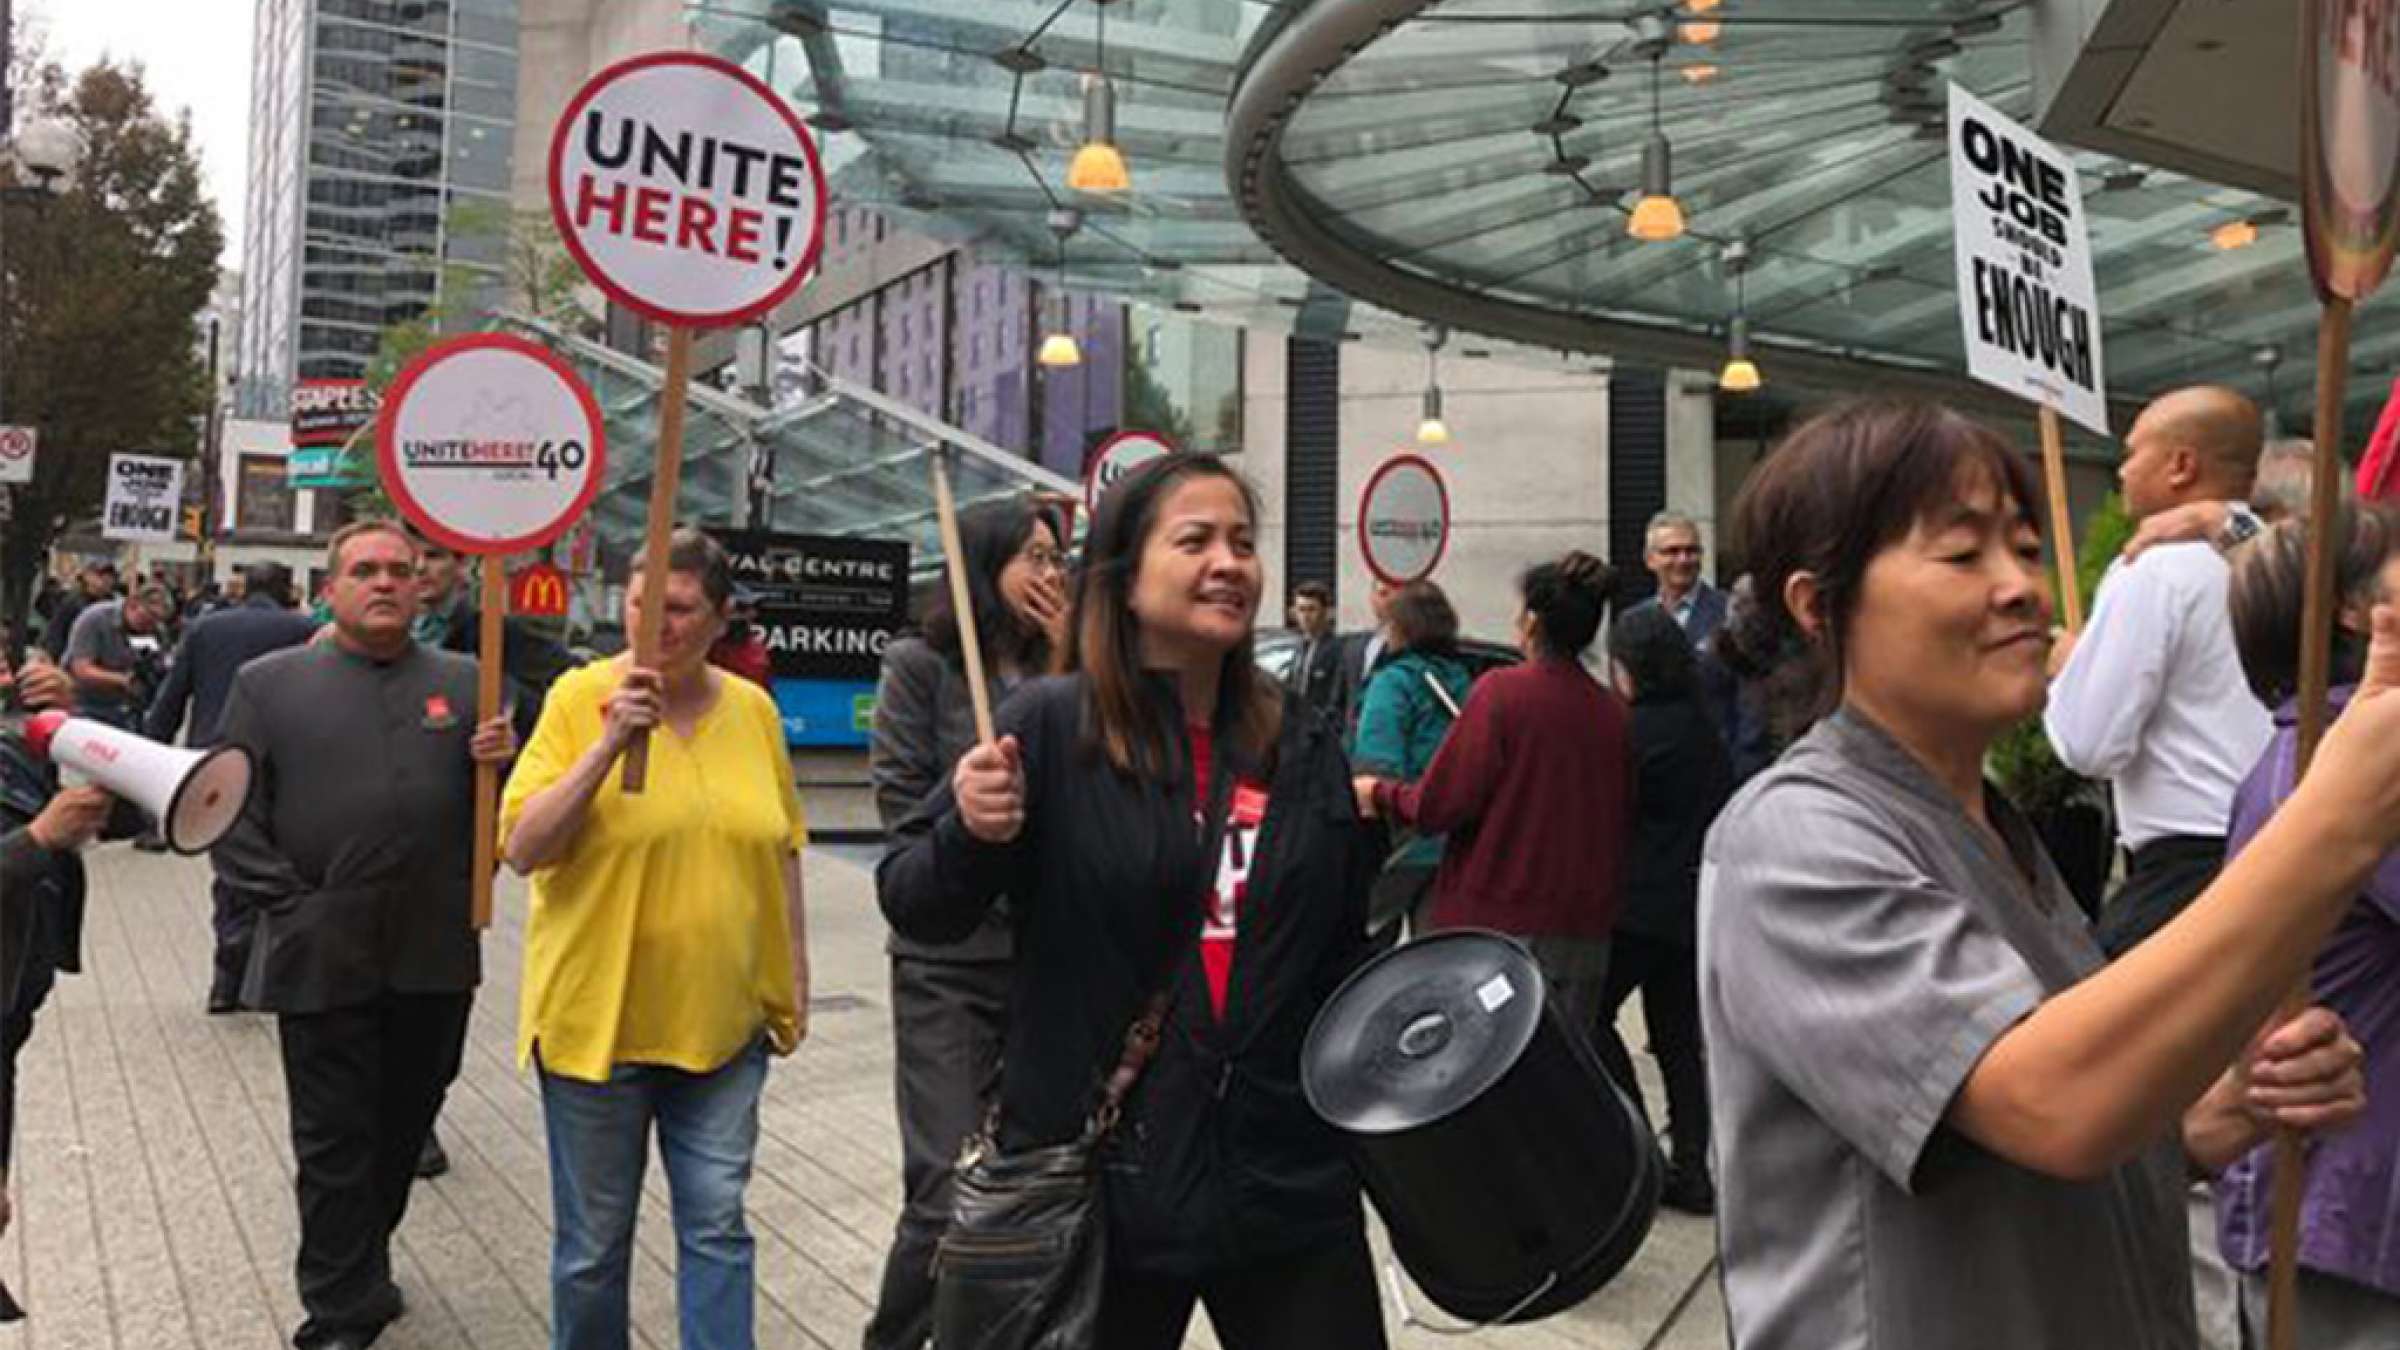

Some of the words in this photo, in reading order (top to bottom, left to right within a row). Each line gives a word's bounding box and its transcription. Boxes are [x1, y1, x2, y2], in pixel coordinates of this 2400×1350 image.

[585, 110, 804, 208] UNITE
[1962, 117, 2071, 219] ONE
[575, 173, 792, 271] HERE!
[1978, 181, 2068, 248] JOB
[2020, 251, 2042, 280] BE
[1972, 255, 2096, 392] ENOUGH
[116, 461, 173, 482] ONE
[536, 439, 585, 481] 40
